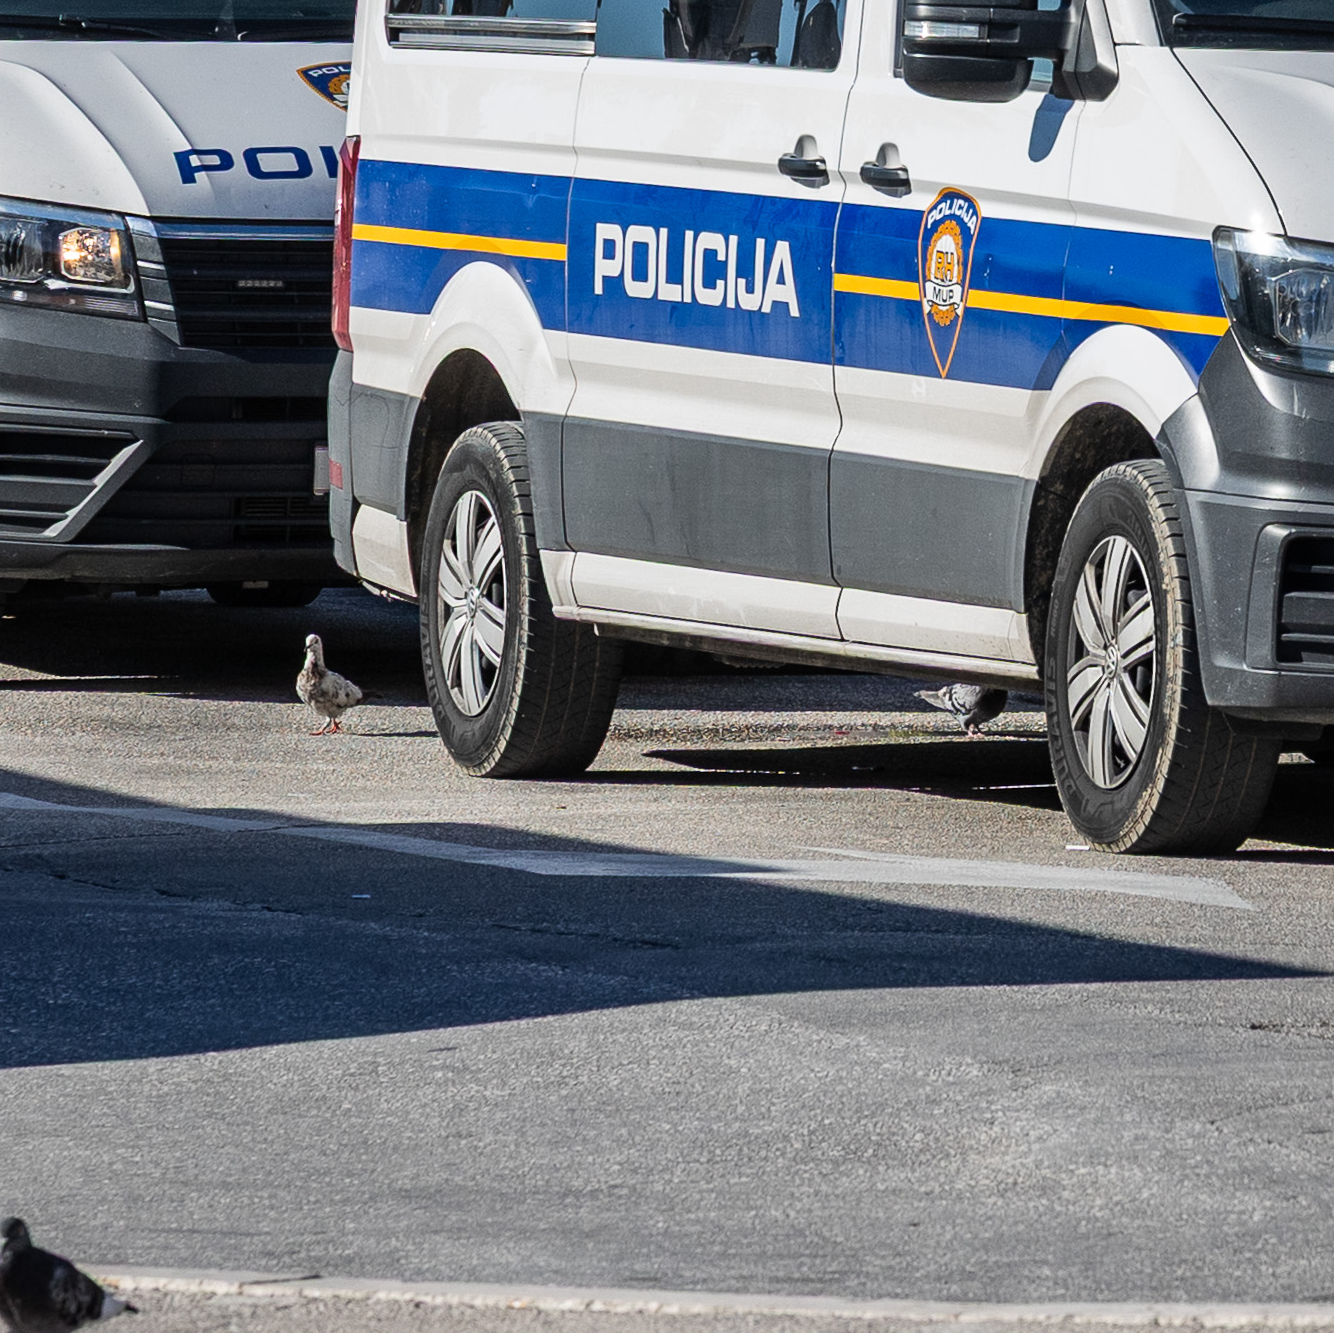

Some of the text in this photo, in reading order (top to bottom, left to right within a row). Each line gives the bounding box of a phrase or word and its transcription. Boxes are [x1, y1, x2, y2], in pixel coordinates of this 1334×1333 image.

[927, 198, 978, 235] POLICIJA
[594, 222, 801, 318] POLICIJA
[932, 287, 954, 303] MUP
